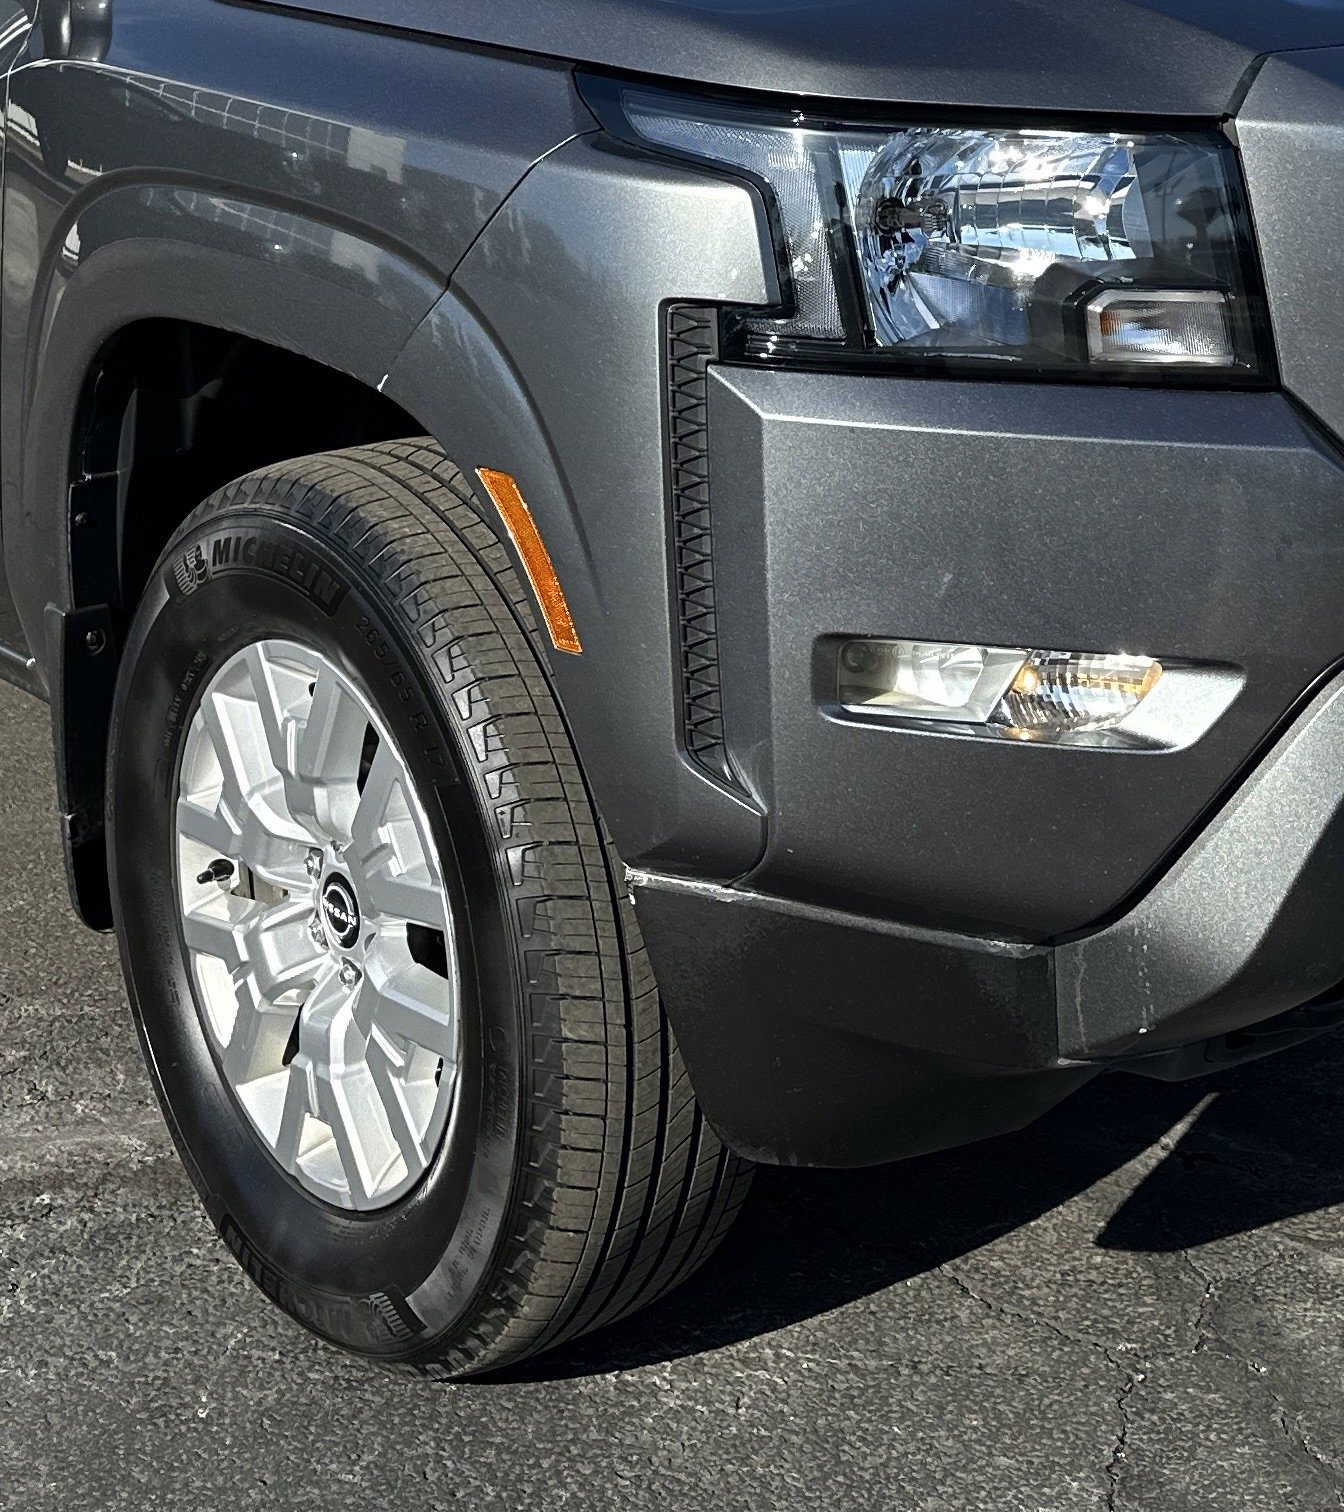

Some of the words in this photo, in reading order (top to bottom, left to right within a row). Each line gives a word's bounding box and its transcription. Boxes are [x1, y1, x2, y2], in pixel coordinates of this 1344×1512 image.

[211, 536, 342, 606] MICHELIN
[409, 711, 430, 733] R
[422, 742, 446, 771] 17
